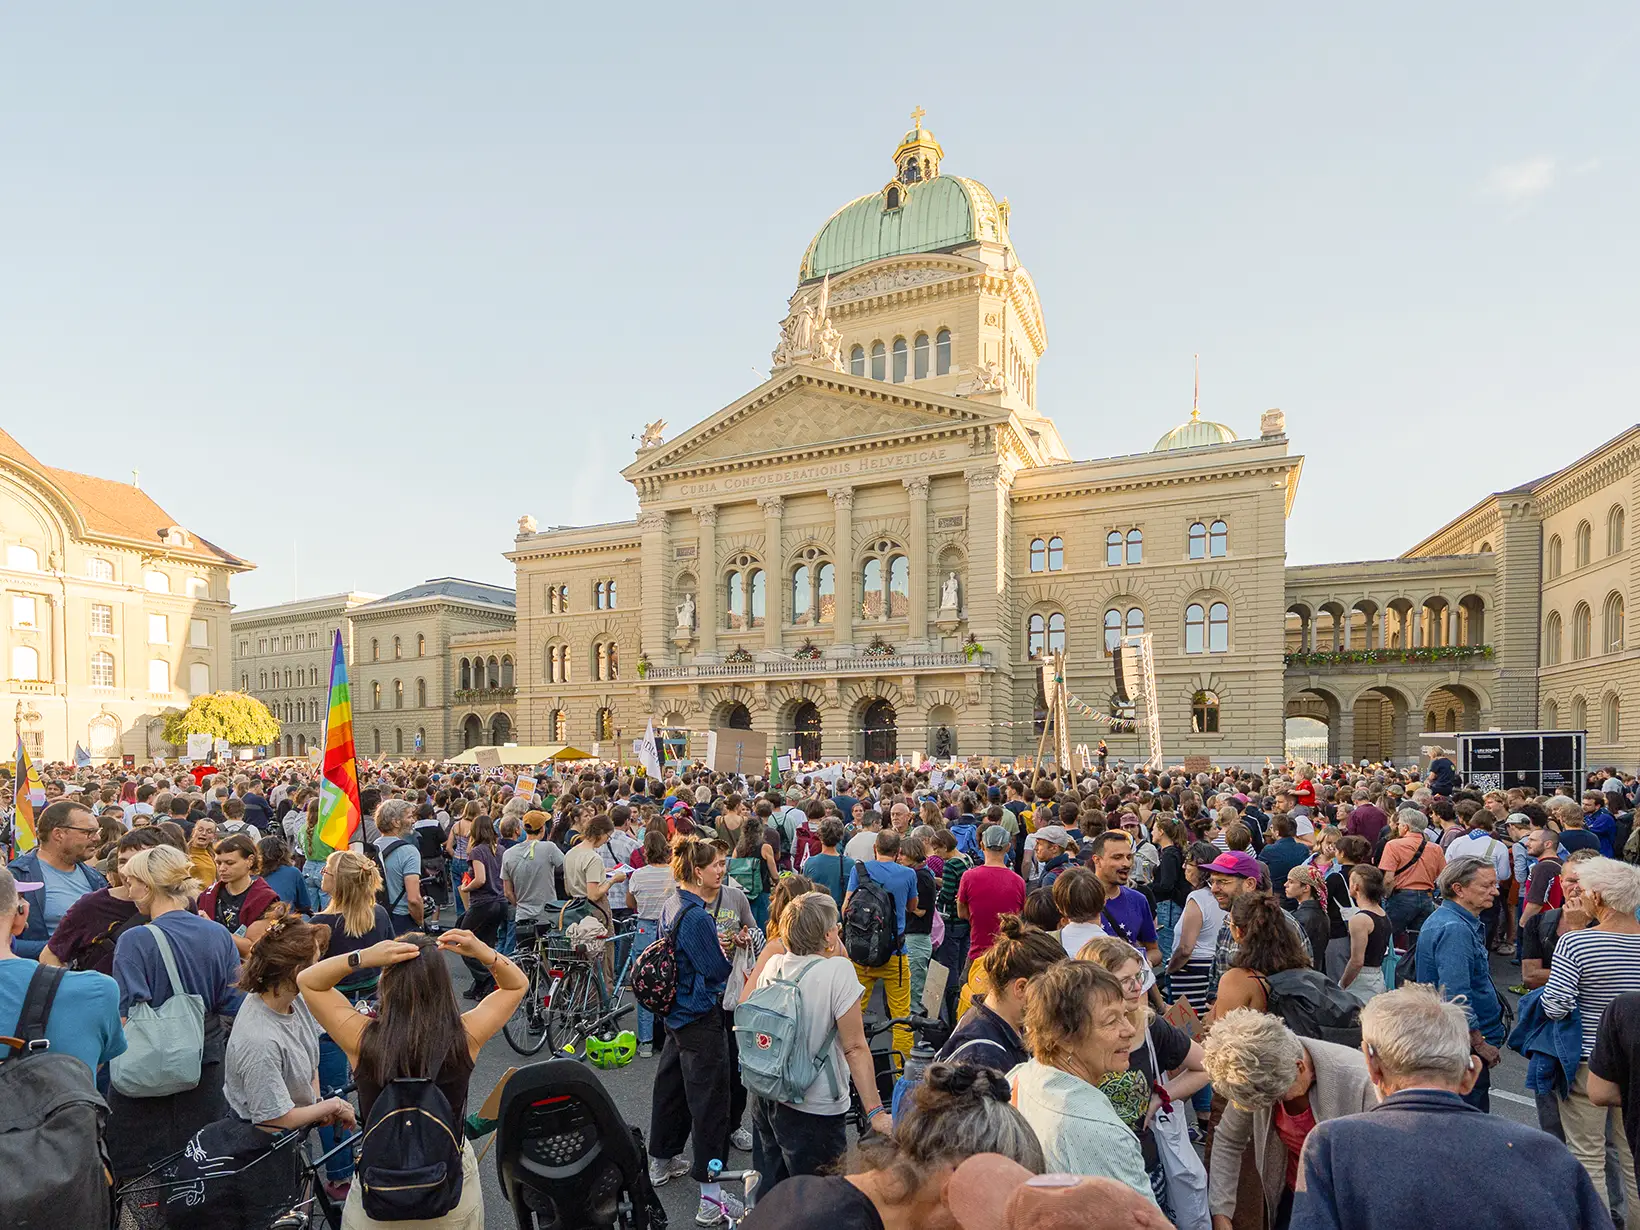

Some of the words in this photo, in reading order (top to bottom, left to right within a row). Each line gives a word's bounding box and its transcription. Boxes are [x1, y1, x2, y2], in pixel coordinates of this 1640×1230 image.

[680, 482, 717, 495] CURIA
[724, 463, 851, 489] CONFOEDERATIONIS
[858, 449, 947, 471] HELVETICAE
